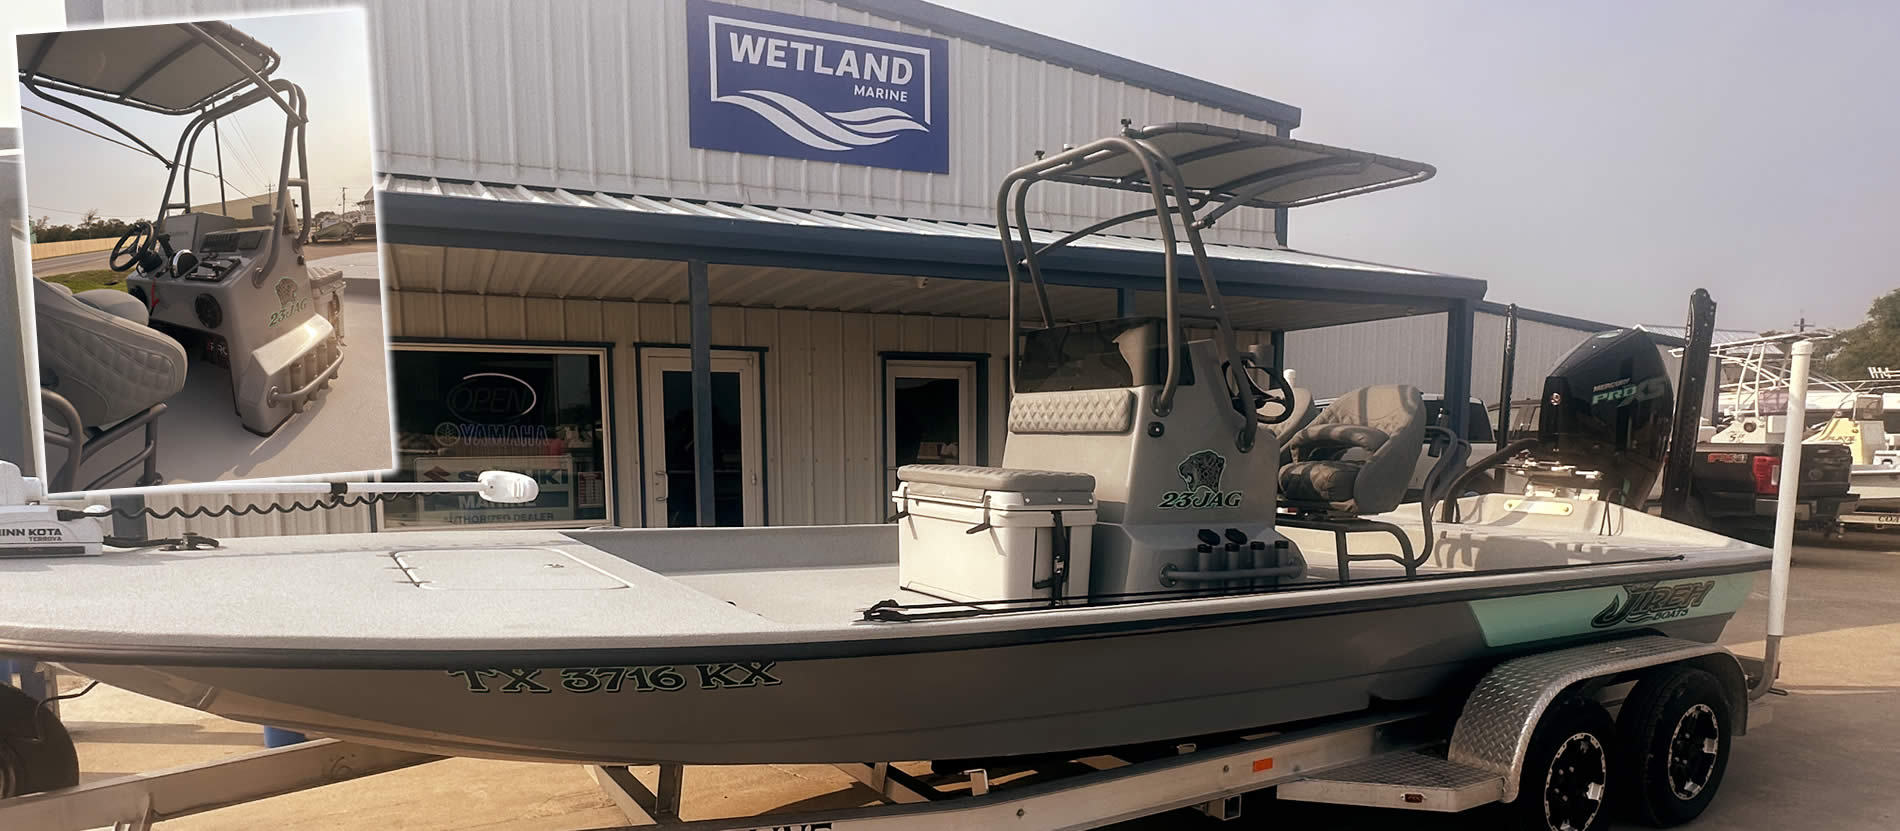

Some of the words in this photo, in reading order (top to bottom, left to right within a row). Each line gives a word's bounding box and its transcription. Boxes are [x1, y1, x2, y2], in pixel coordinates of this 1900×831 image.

[729, 32, 913, 86] WETLAND
[853, 84, 908, 103] MARINE
[450, 386, 529, 413] OPEN
[1592, 385, 1637, 405] PRO
[459, 423, 549, 447] YAMAHA
[1157, 489, 1243, 508] 23JAG
[443, 513, 512, 525] UTHORIZED
[513, 512, 554, 522] DEALER
[0, 528, 25, 537] INN
[28, 528, 62, 536] KOTA
[1653, 608, 1689, 621] BOATS
[447, 664, 552, 694] TX
[560, 665, 687, 693] 3716
[695, 660, 782, 689] KX
